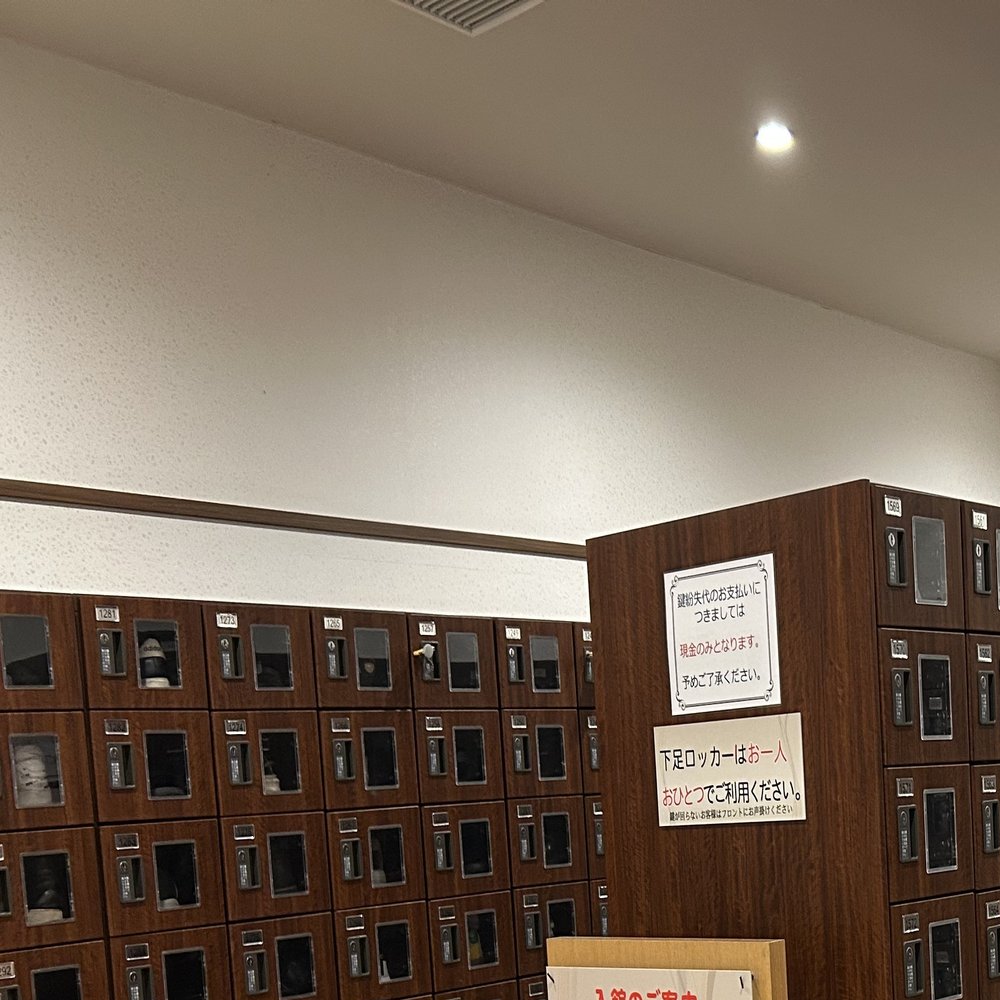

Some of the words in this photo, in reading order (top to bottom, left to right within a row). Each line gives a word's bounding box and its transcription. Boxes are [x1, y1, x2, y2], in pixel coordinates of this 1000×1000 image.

[677, 581, 762, 609] 鍵紛失代のお支払いに
[99, 609, 117, 619] 1281
[694, 603, 746, 624] つきましては
[680, 634, 759, 659] 現金のみとなります。
[682, 668, 761, 690] 予めご了承ください。
[659, 740, 788, 772] 下足ロッカーはお一人
[662, 779, 801, 808] おひとつでご利用ください。
